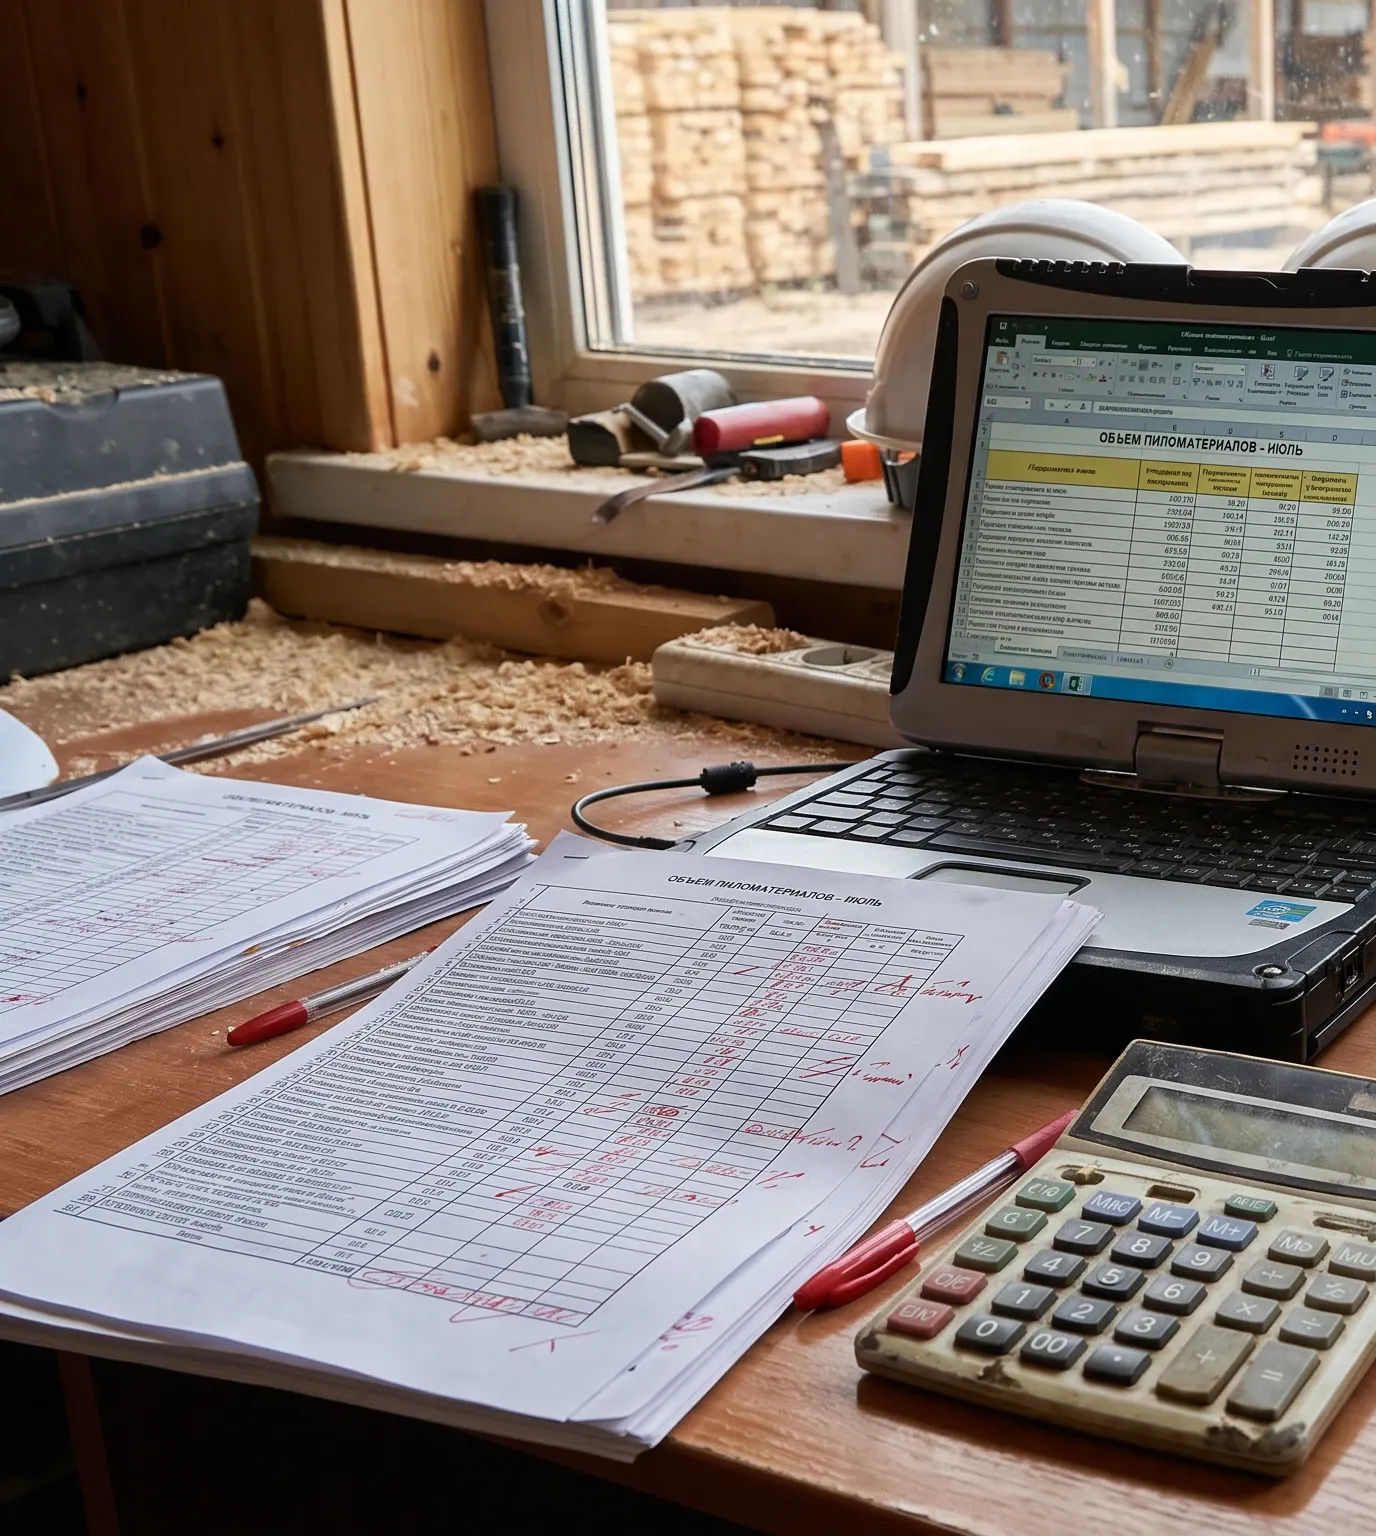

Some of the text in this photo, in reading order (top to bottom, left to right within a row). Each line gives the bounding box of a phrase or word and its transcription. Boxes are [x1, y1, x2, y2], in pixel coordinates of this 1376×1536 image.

[1144, 434, 1257, 453] ПИЛОМАТЕРИАЛОВ
[1268, 443, 1303, 456] ИЮЛЬ
[714, 880, 835, 901] ПИЛОМАТЕРИАЛОВ
[1073, 1225, 1095, 1240] 7
[1206, 1219, 1241, 1235] M+
[1130, 1239, 1152, 1254] 8
[1042, 1257, 1063, 1272] 4
[1190, 1251, 1212, 1267] 9
[1102, 1269, 1123, 1284] 5
[1015, 1289, 1031, 1305] 1
[1163, 1283, 1185, 1299] 6
[1070, 1303, 1095, 1319] 2
[975, 1320, 998, 1337] 0
[1133, 1316, 1157, 1333] 3
[1030, 1333, 1069, 1353] 00
